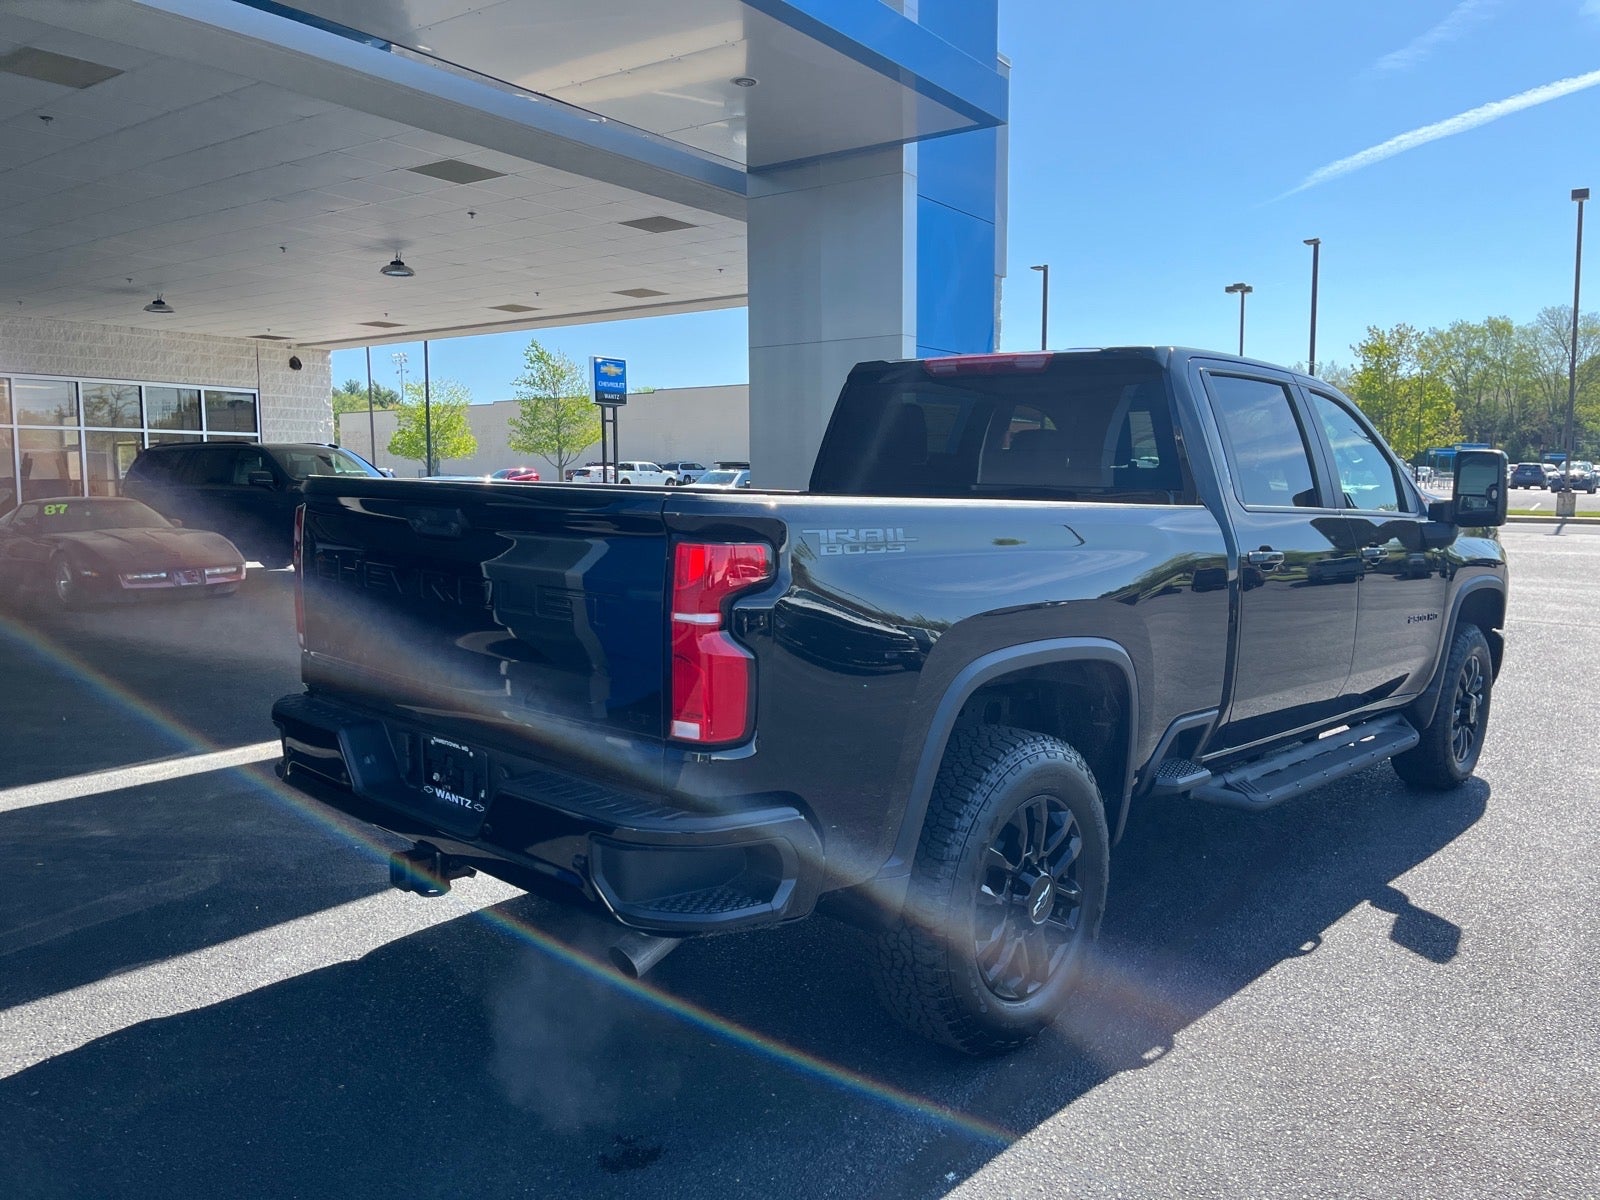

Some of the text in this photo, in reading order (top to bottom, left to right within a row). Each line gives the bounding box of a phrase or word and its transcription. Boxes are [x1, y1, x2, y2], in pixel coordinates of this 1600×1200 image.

[44, 503, 68, 516] 87
[802, 527, 919, 544] TRAIL
[820, 541, 906, 556] BOSS
[435, 787, 472, 809] WANTZ
